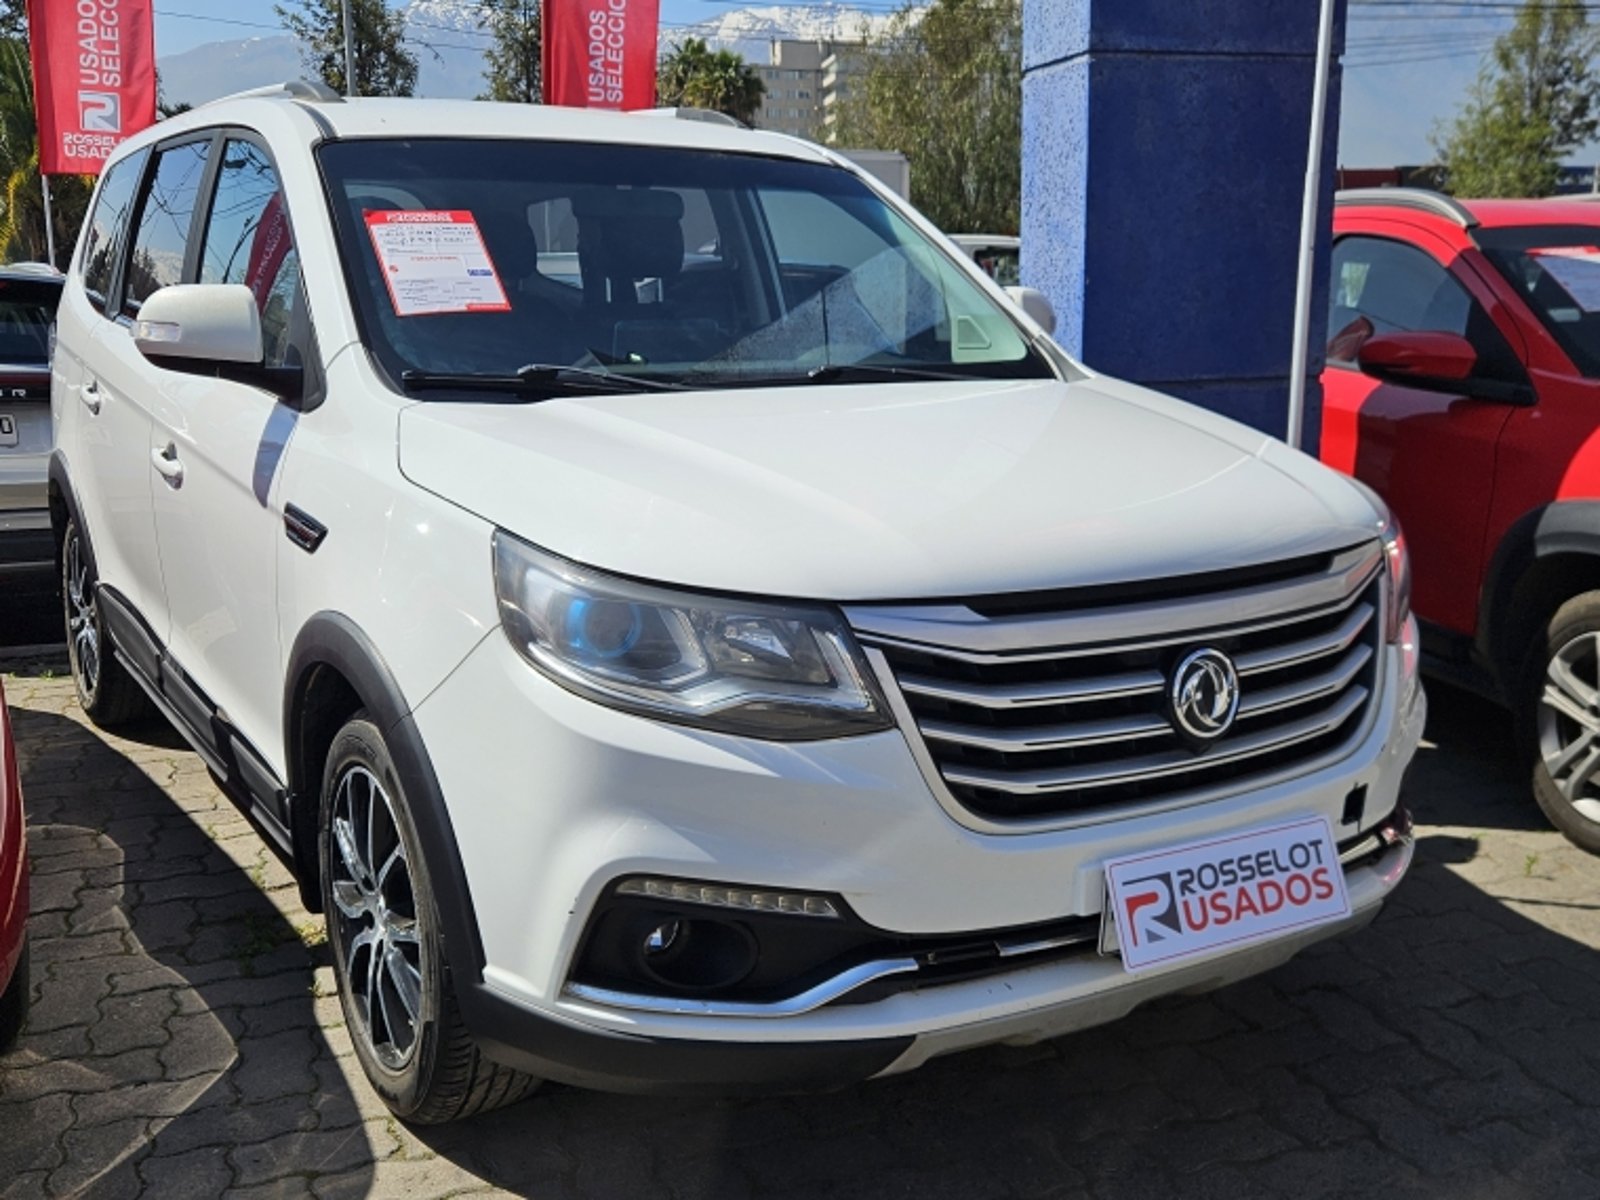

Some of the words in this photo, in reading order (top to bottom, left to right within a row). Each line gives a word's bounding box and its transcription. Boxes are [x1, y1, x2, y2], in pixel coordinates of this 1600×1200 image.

[588, 10, 607, 102] USADOS
[1177, 839, 1323, 896] ROSSELOT
[1183, 867, 1334, 931] USADOS
